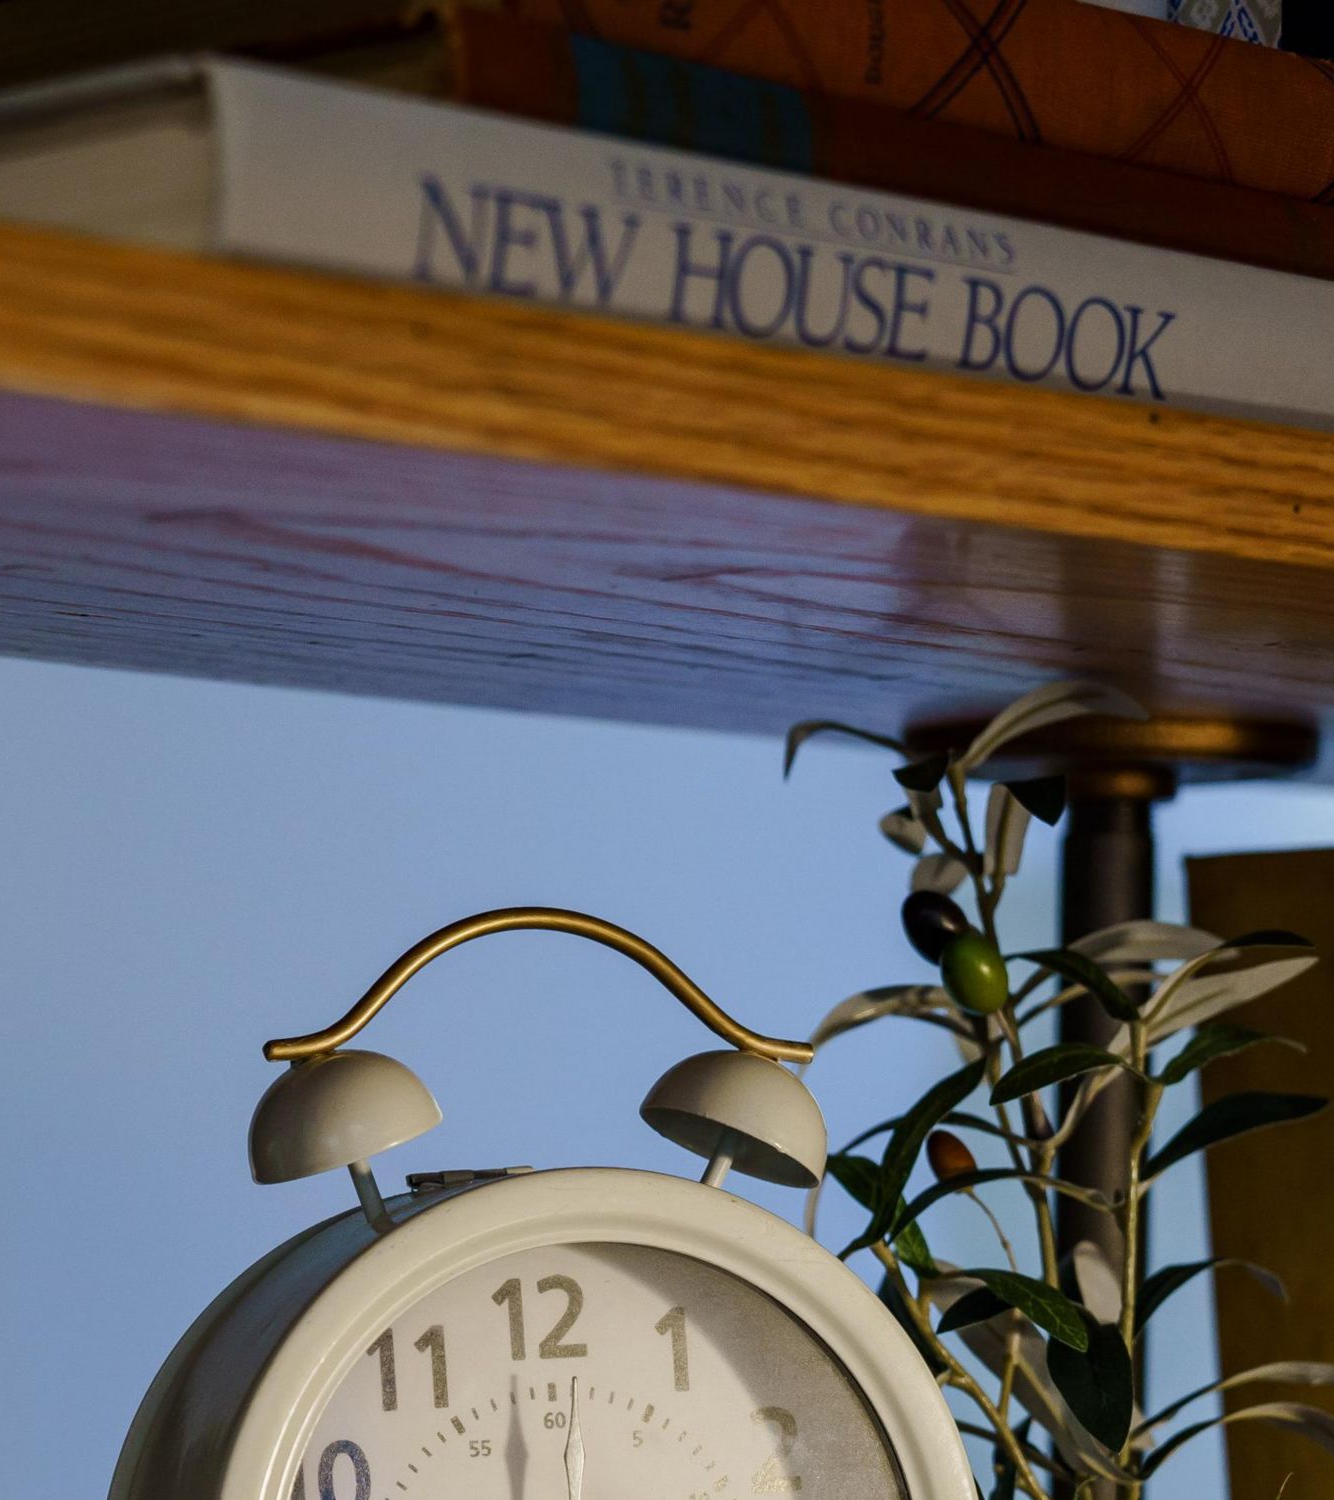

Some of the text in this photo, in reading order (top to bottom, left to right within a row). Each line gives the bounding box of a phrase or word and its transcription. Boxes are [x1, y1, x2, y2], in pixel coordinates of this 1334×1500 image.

[610, 157, 804, 229] TERENCE
[414, 169, 1177, 400] NEW HOUSE BOOK
[491, 1274, 588, 1361] 12
[654, 1305, 690, 1392] 1
[366, 1325, 449, 1412] 11
[469, 1440, 492, 1458] 55
[543, 1411, 567, 1430] 60
[632, 1430, 644, 1448] 5
[749, 1406, 803, 1494] 2
